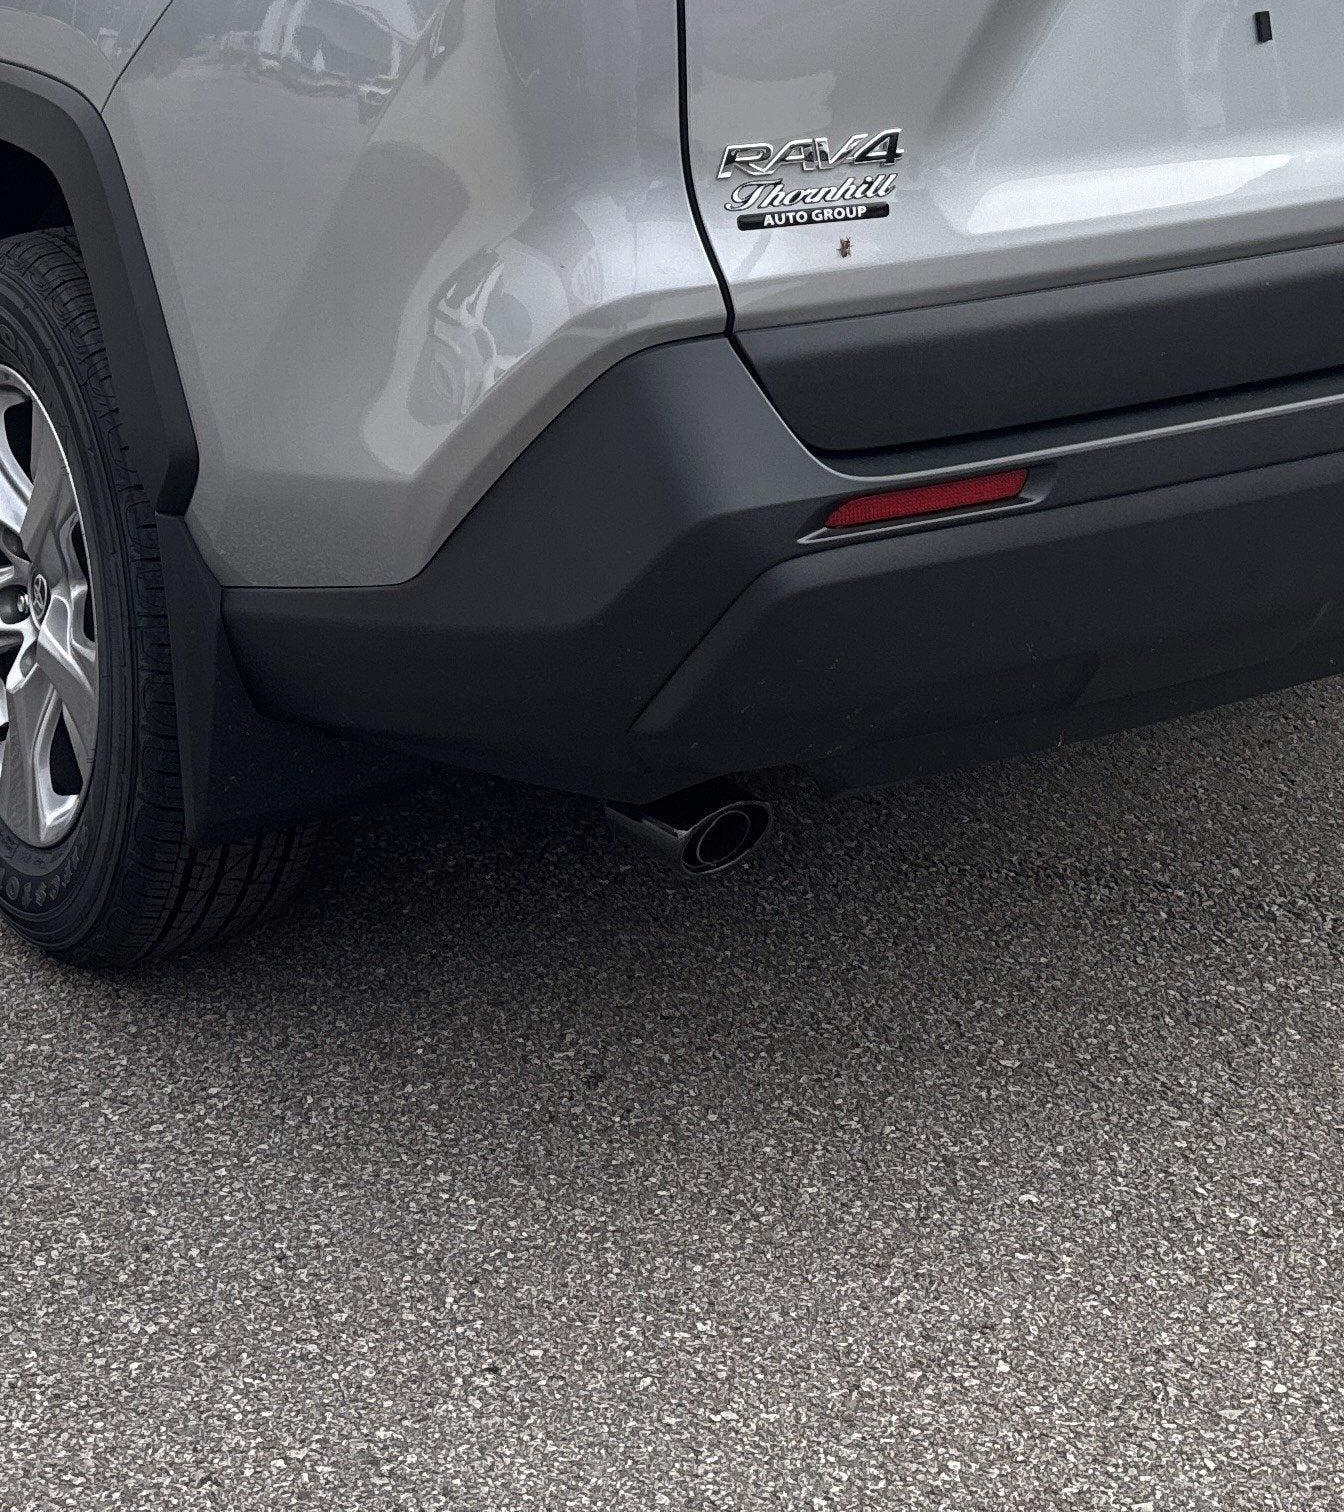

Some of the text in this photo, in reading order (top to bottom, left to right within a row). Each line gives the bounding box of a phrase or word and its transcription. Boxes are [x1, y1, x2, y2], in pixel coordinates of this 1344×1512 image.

[716, 128, 905, 179] RAV4
[724, 173, 899, 211] Thornhill
[763, 205, 867, 227] AUTO GROUP
